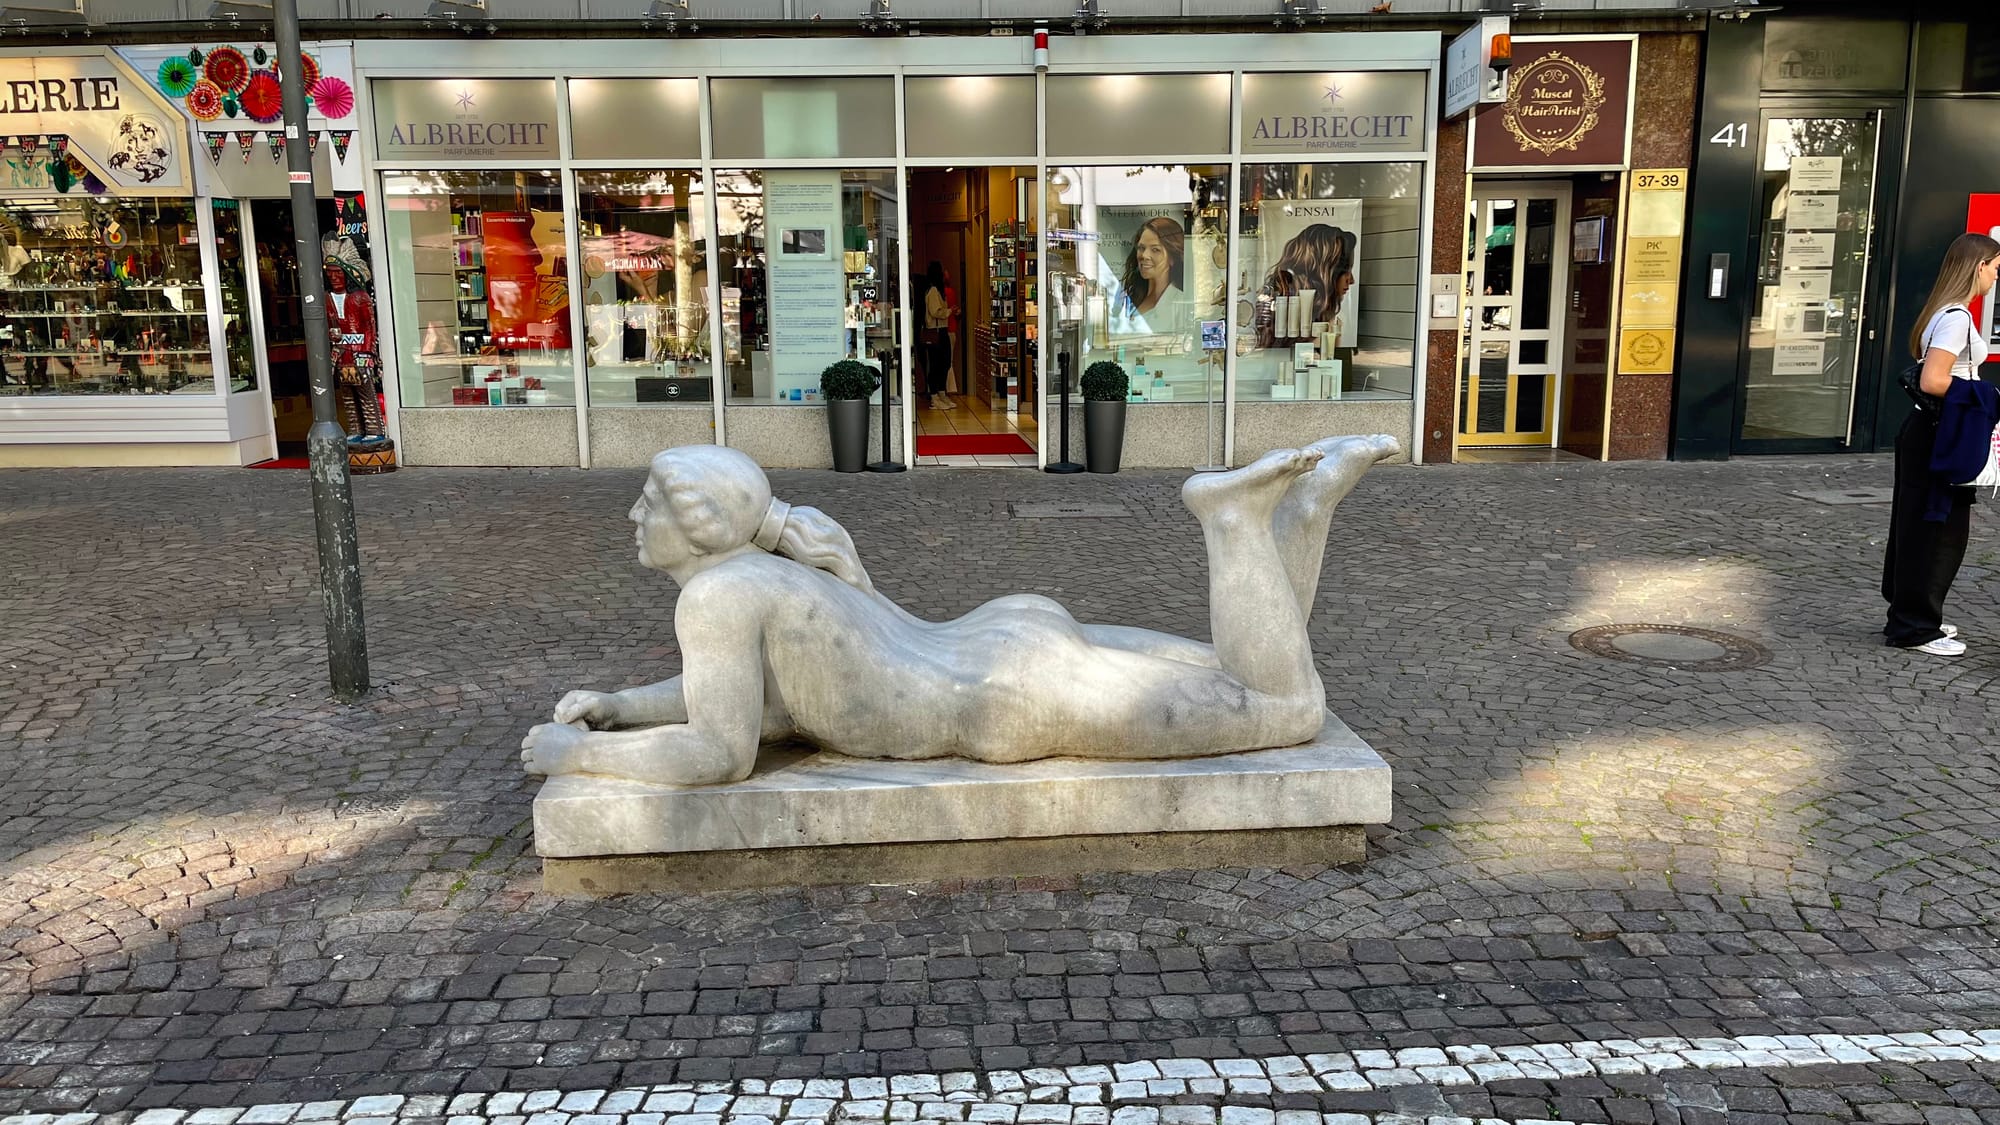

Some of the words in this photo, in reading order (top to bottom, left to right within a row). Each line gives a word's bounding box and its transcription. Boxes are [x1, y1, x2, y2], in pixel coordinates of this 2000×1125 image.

[1448, 64, 1479, 100] ALBRECHT
[1531, 88, 1573, 99] Muscal
[1252, 115, 1413, 139] ALBRECHT
[388, 123, 548, 145] ALBRECHT
[1710, 122, 1747, 148] 41
[22, 141, 35, 152] 50
[208, 137, 225, 147] 1976
[240, 137, 252, 147] 50
[332, 137, 349, 147] 1976
[1638, 175, 1679, 187] 37-39
[1285, 206, 1335, 217] SENSAI
